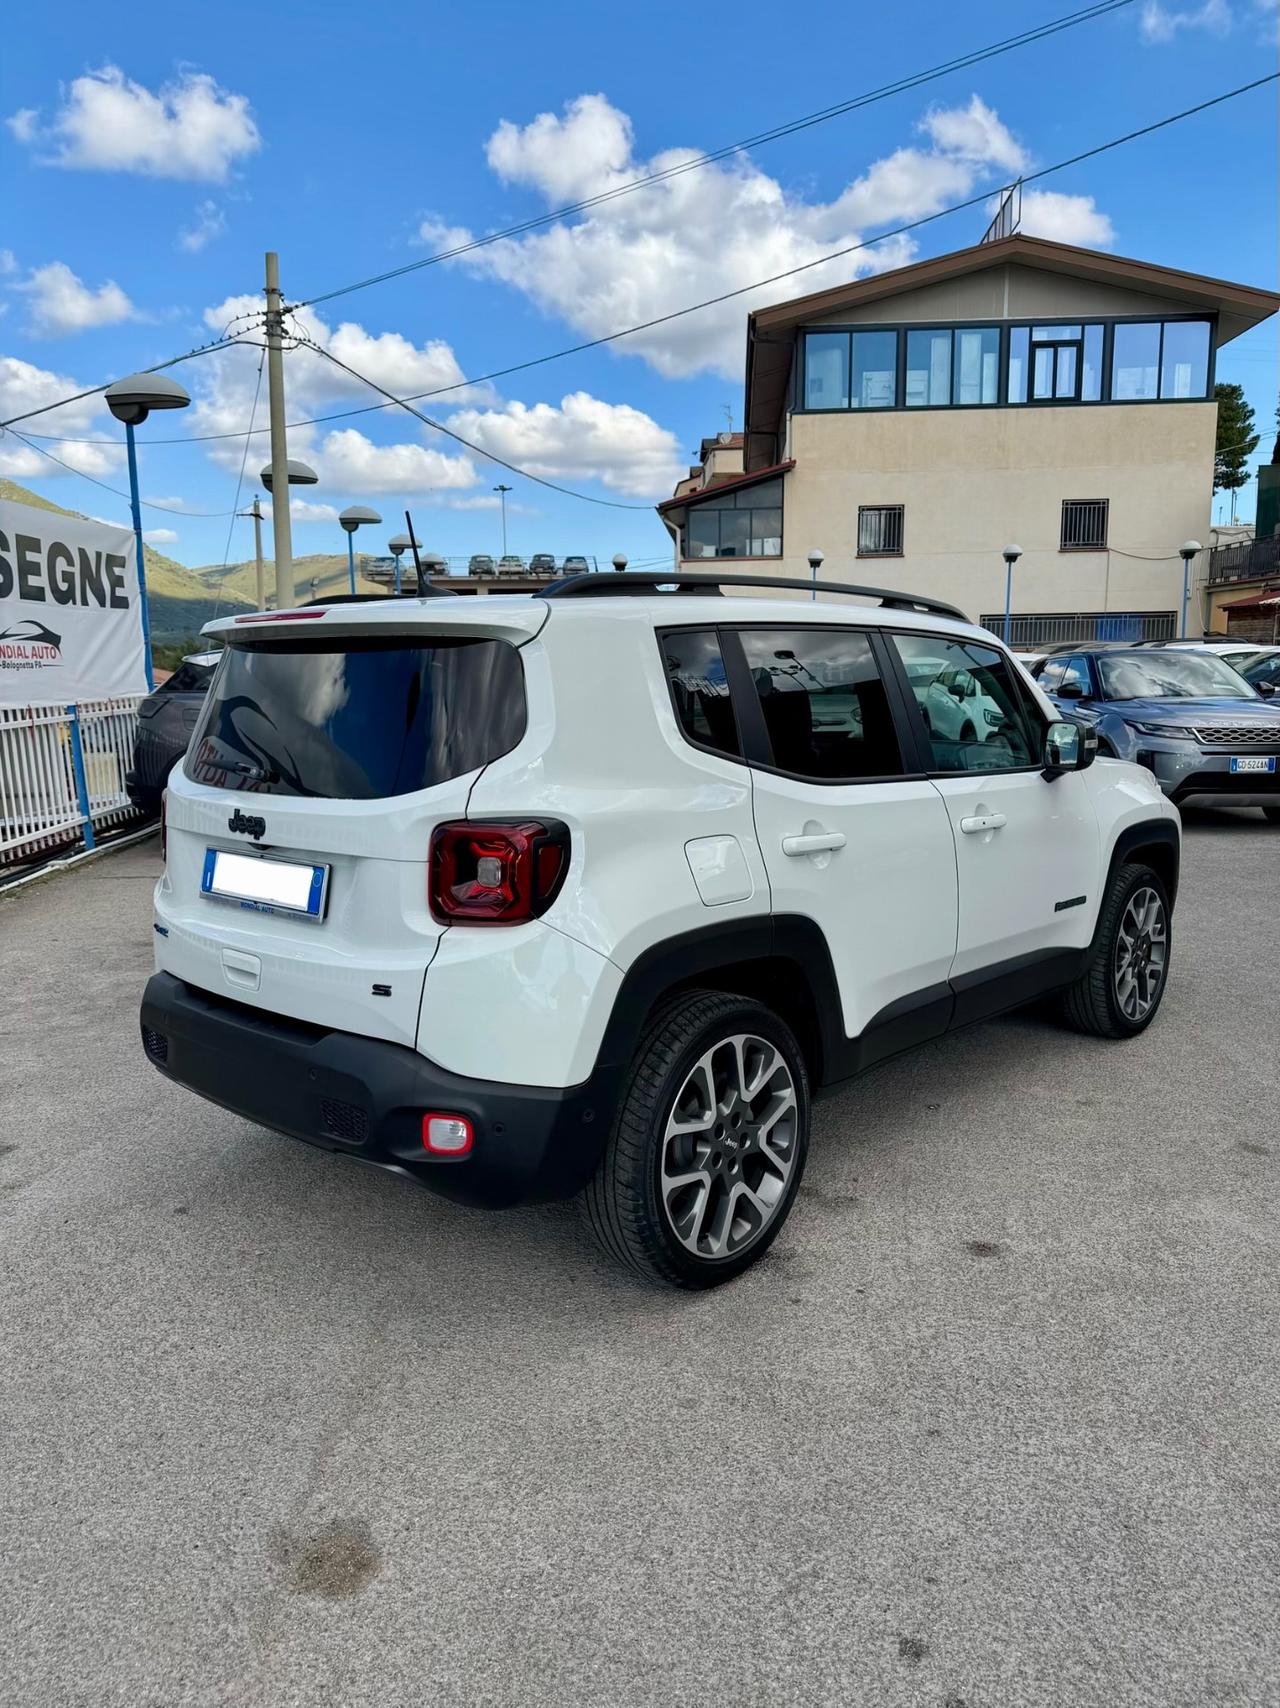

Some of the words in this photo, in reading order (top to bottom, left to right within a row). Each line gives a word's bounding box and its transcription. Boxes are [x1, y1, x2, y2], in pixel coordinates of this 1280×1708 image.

[31, 646, 57, 659] AUTO
[228, 808, 266, 840] Jeep
[371, 983, 392, 997] S
